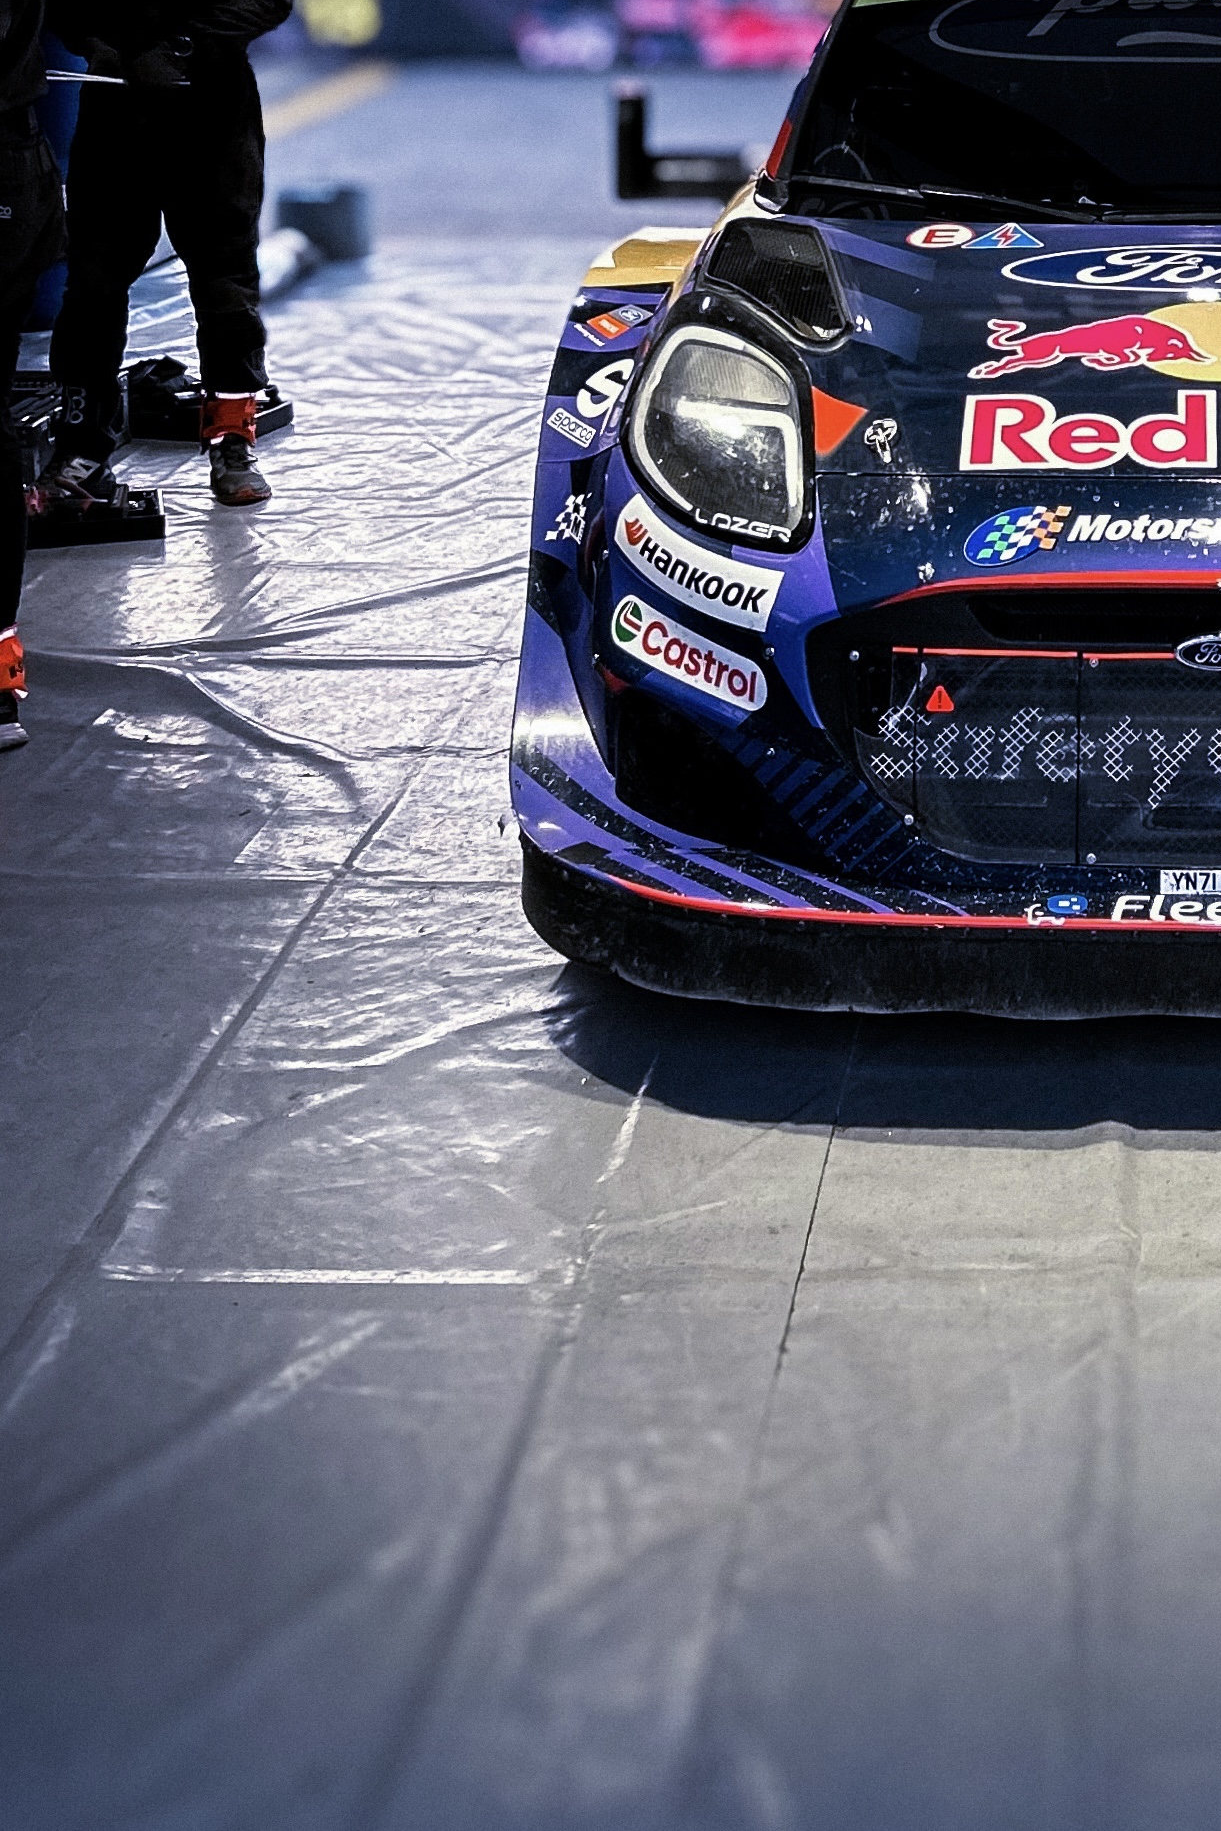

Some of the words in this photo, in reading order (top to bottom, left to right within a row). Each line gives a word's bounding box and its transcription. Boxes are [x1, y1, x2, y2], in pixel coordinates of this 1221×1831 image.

[924, 228, 958, 245] E
[553, 411, 594, 443] sparco
[969, 393, 1207, 465] Red
[695, 507, 792, 543] LAZER
[641, 620, 758, 703] Castrol
[1171, 872, 1218, 892] YN71
